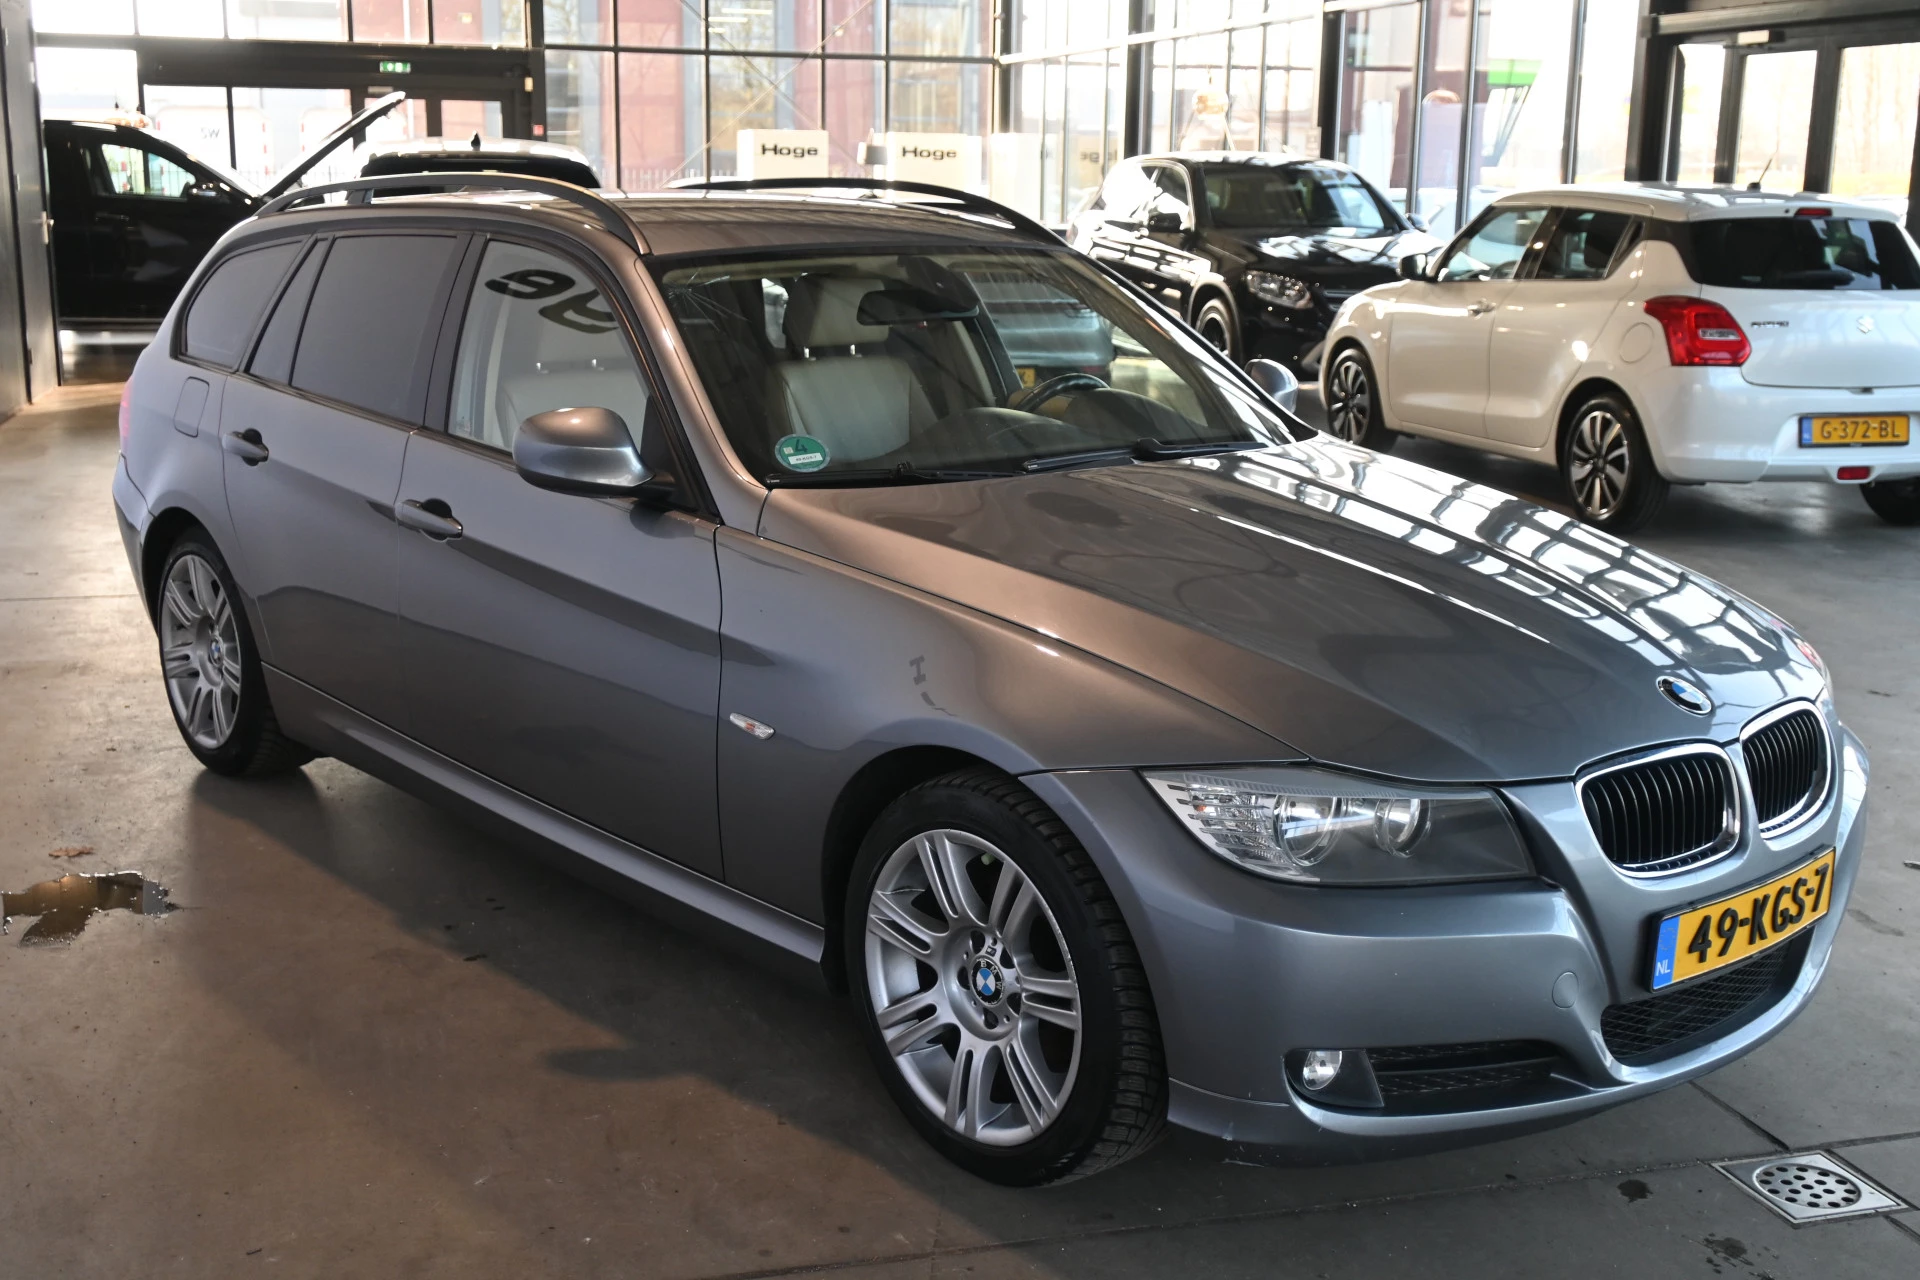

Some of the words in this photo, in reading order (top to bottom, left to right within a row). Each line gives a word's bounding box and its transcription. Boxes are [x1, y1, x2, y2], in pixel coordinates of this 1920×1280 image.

[761, 144, 818, 158] Hoge
[902, 146, 957, 160] Hoge
[1821, 420, 1901, 439] G-372-BL
[1655, 959, 1671, 976] NL
[1688, 862, 1830, 963] 49-KGS-7
[980, 960, 1002, 990] BMW
